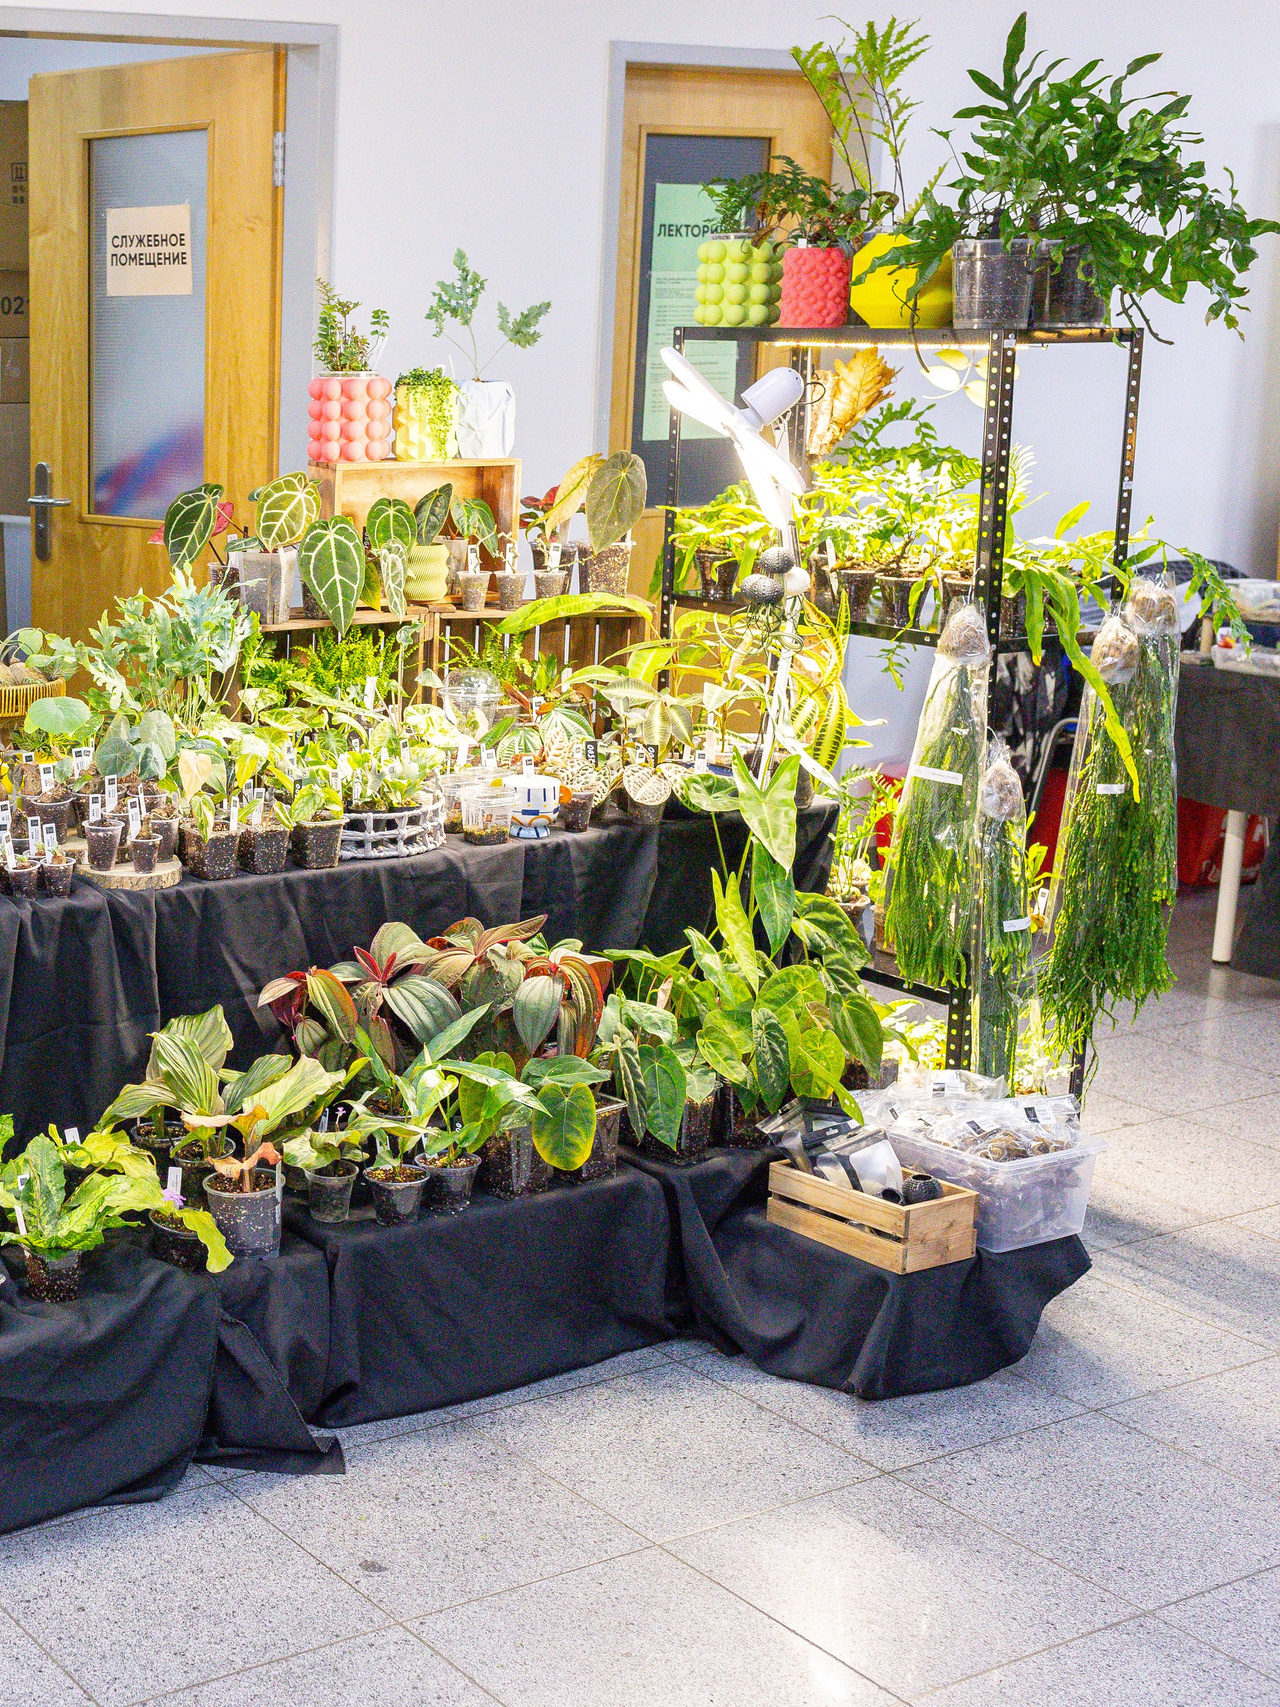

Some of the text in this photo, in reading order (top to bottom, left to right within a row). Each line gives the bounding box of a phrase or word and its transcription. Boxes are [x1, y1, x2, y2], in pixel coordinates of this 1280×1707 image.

[657, 224, 720, 238] ЛЕКТОРИ
[111, 233, 186, 248] СЛУЖЕБНОЕ
[110, 251, 188, 267] ПОМЕЩЕНИЕ
[0, 296, 29, 316] 02
